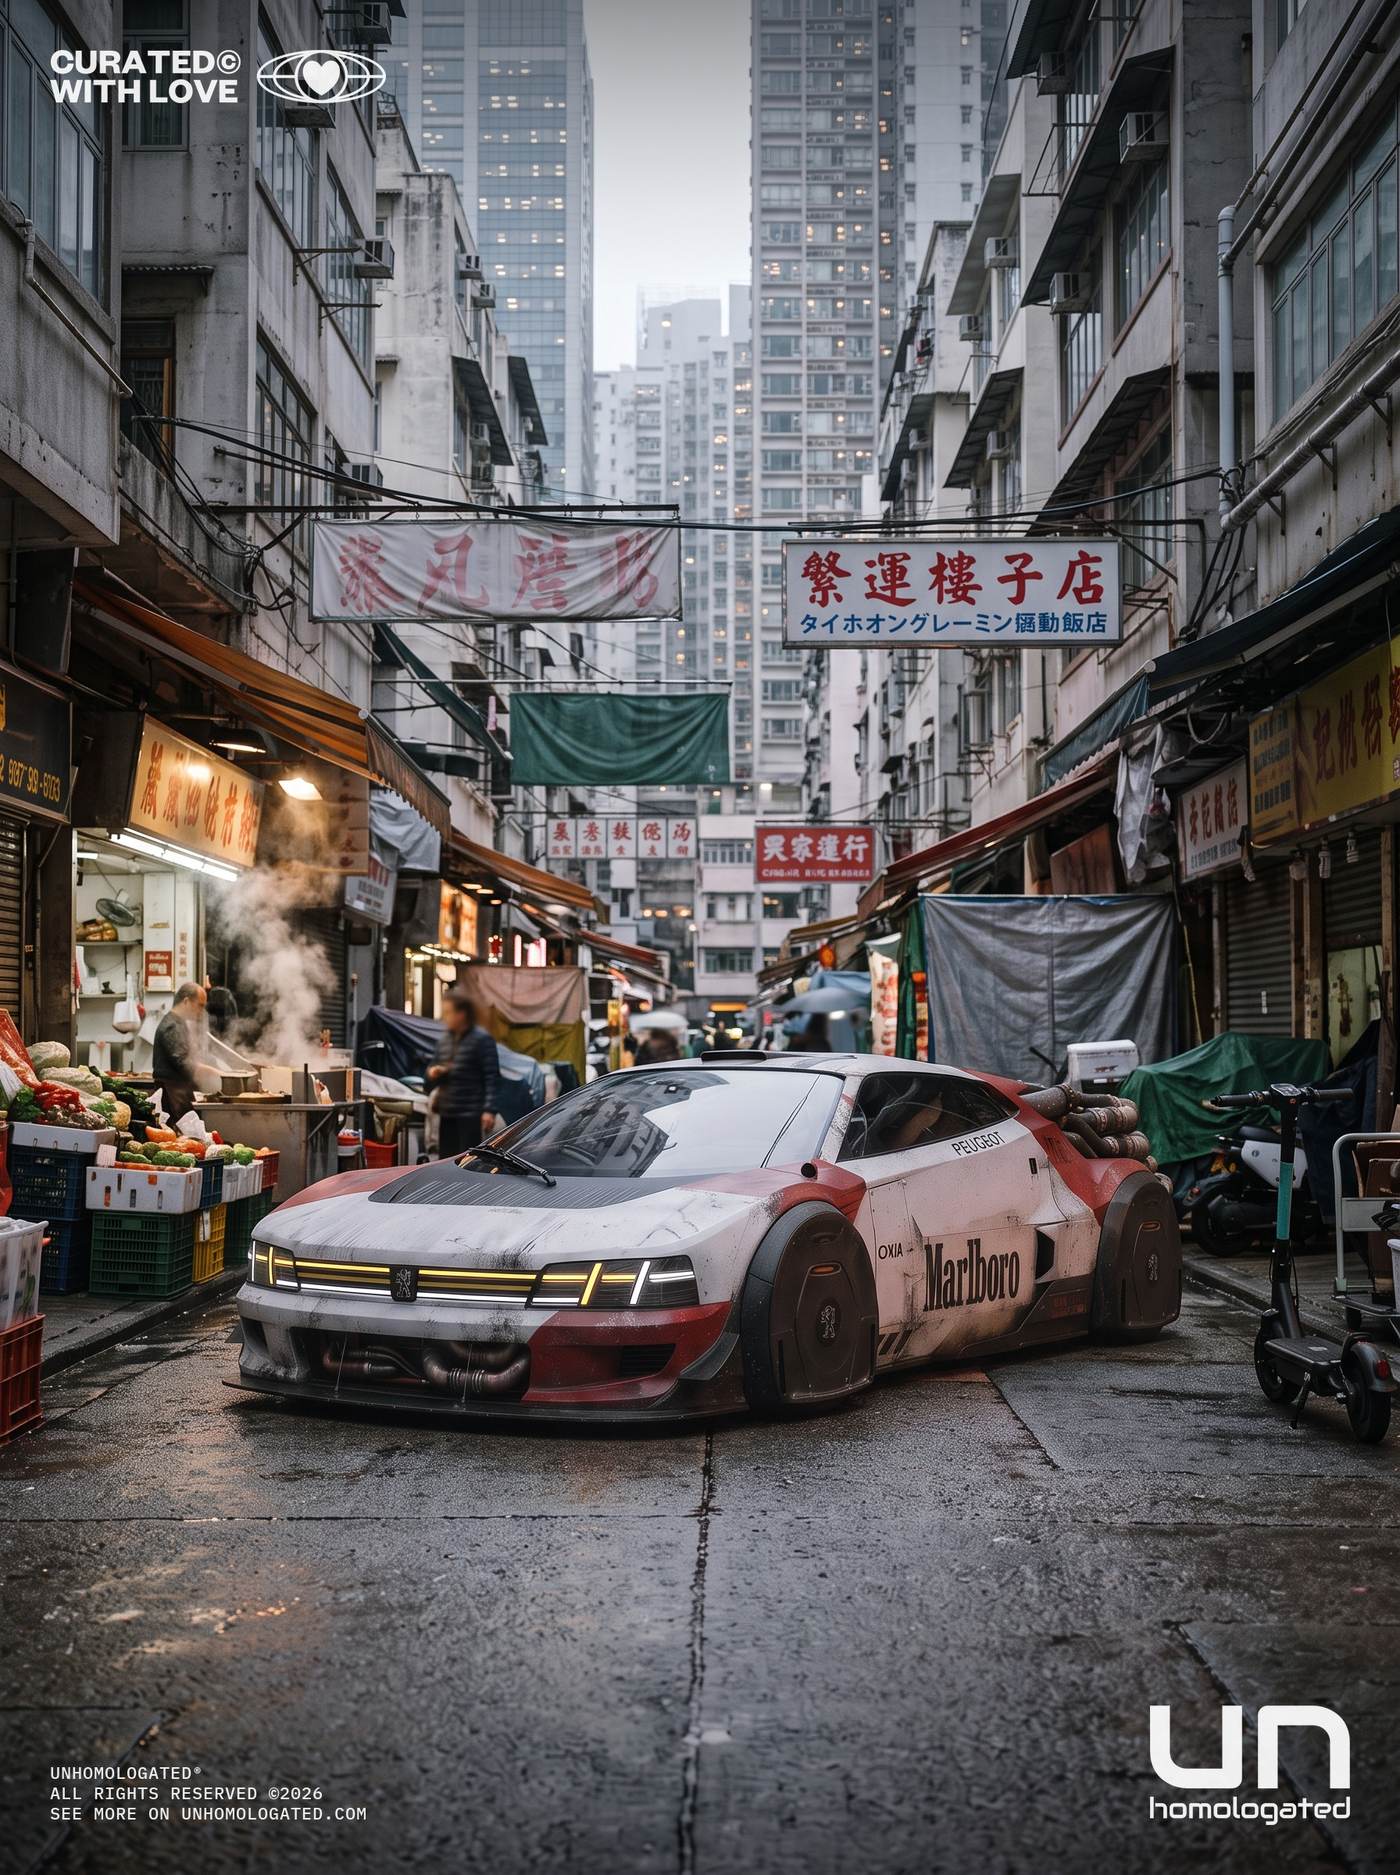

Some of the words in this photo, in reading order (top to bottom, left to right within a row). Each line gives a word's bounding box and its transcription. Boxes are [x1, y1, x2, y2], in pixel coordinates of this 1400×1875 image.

[951, 1131, 1006, 1156] PEUGEOT
[878, 1242, 904, 1260] OXIA
[922, 1238, 1021, 1312] Marlboro
